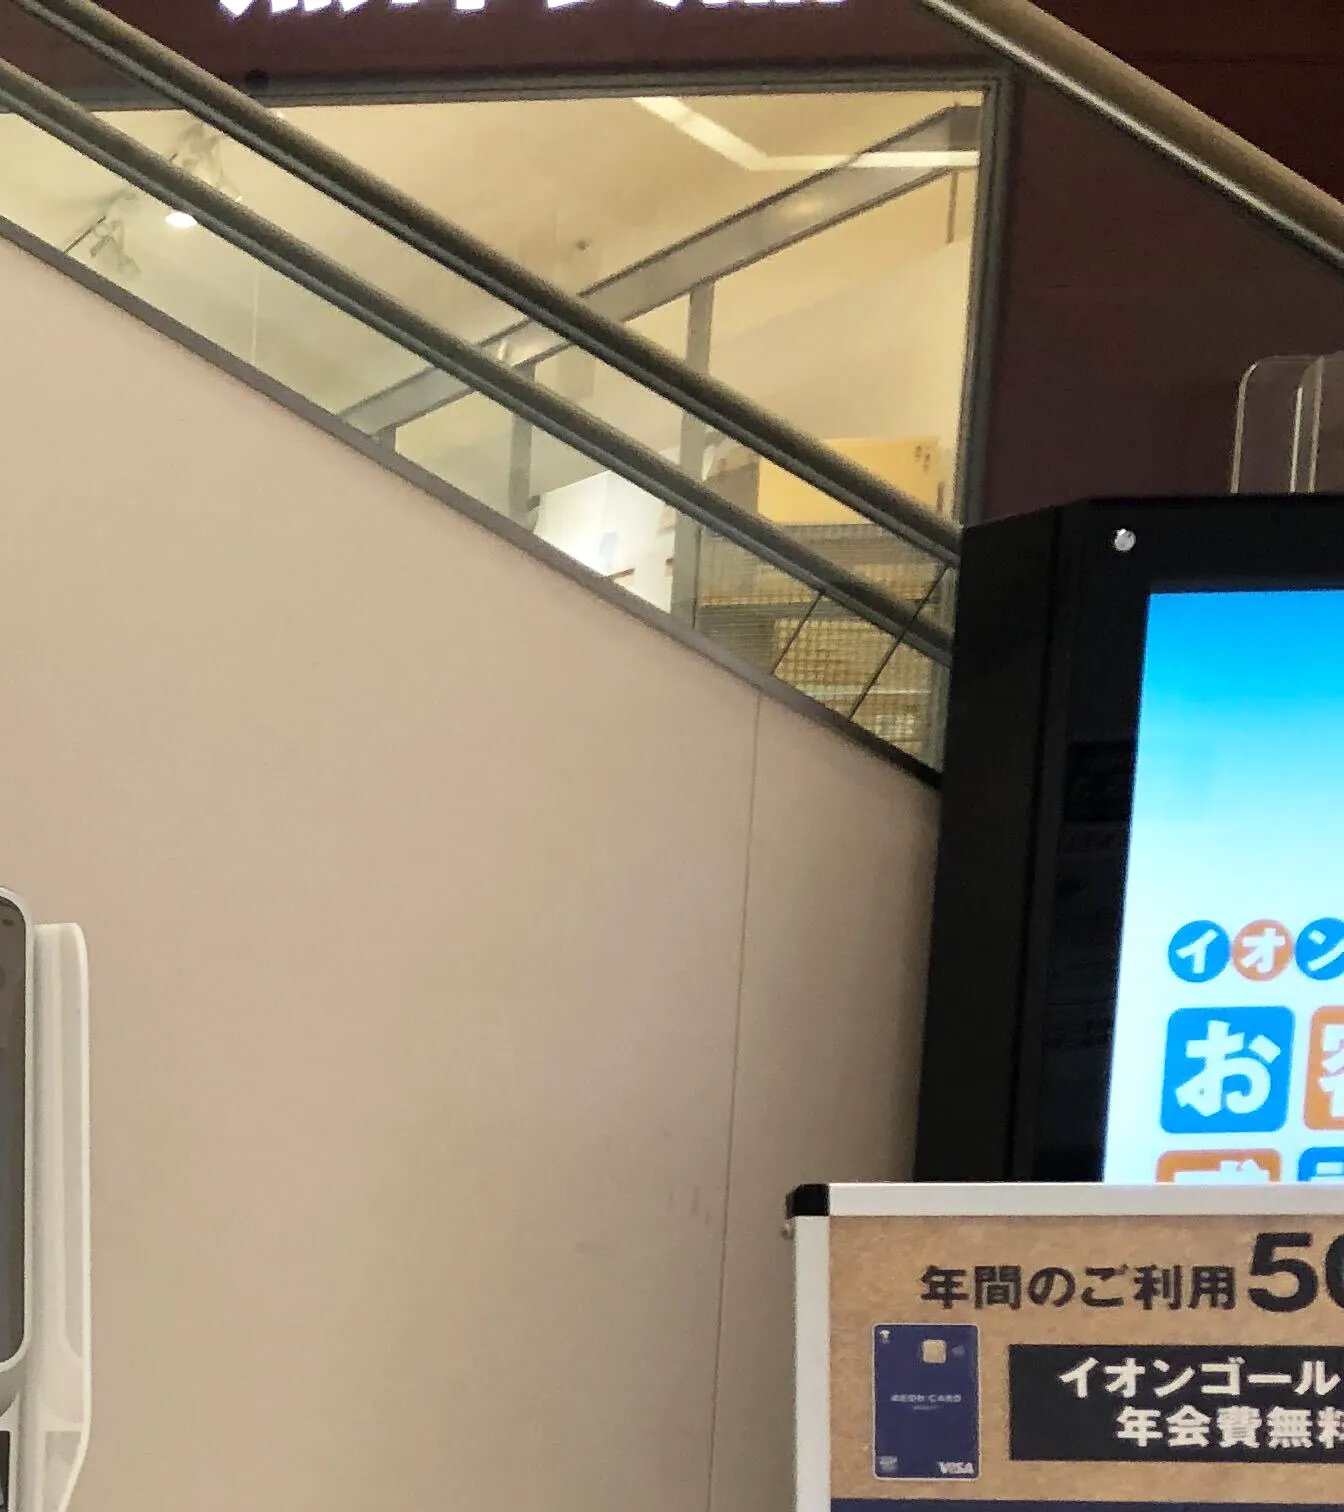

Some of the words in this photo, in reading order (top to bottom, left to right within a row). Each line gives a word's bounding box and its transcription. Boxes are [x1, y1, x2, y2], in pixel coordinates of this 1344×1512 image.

[1175, 1020, 1344, 1117] お
[1060, 1357, 1340, 1398] イオンゴール
